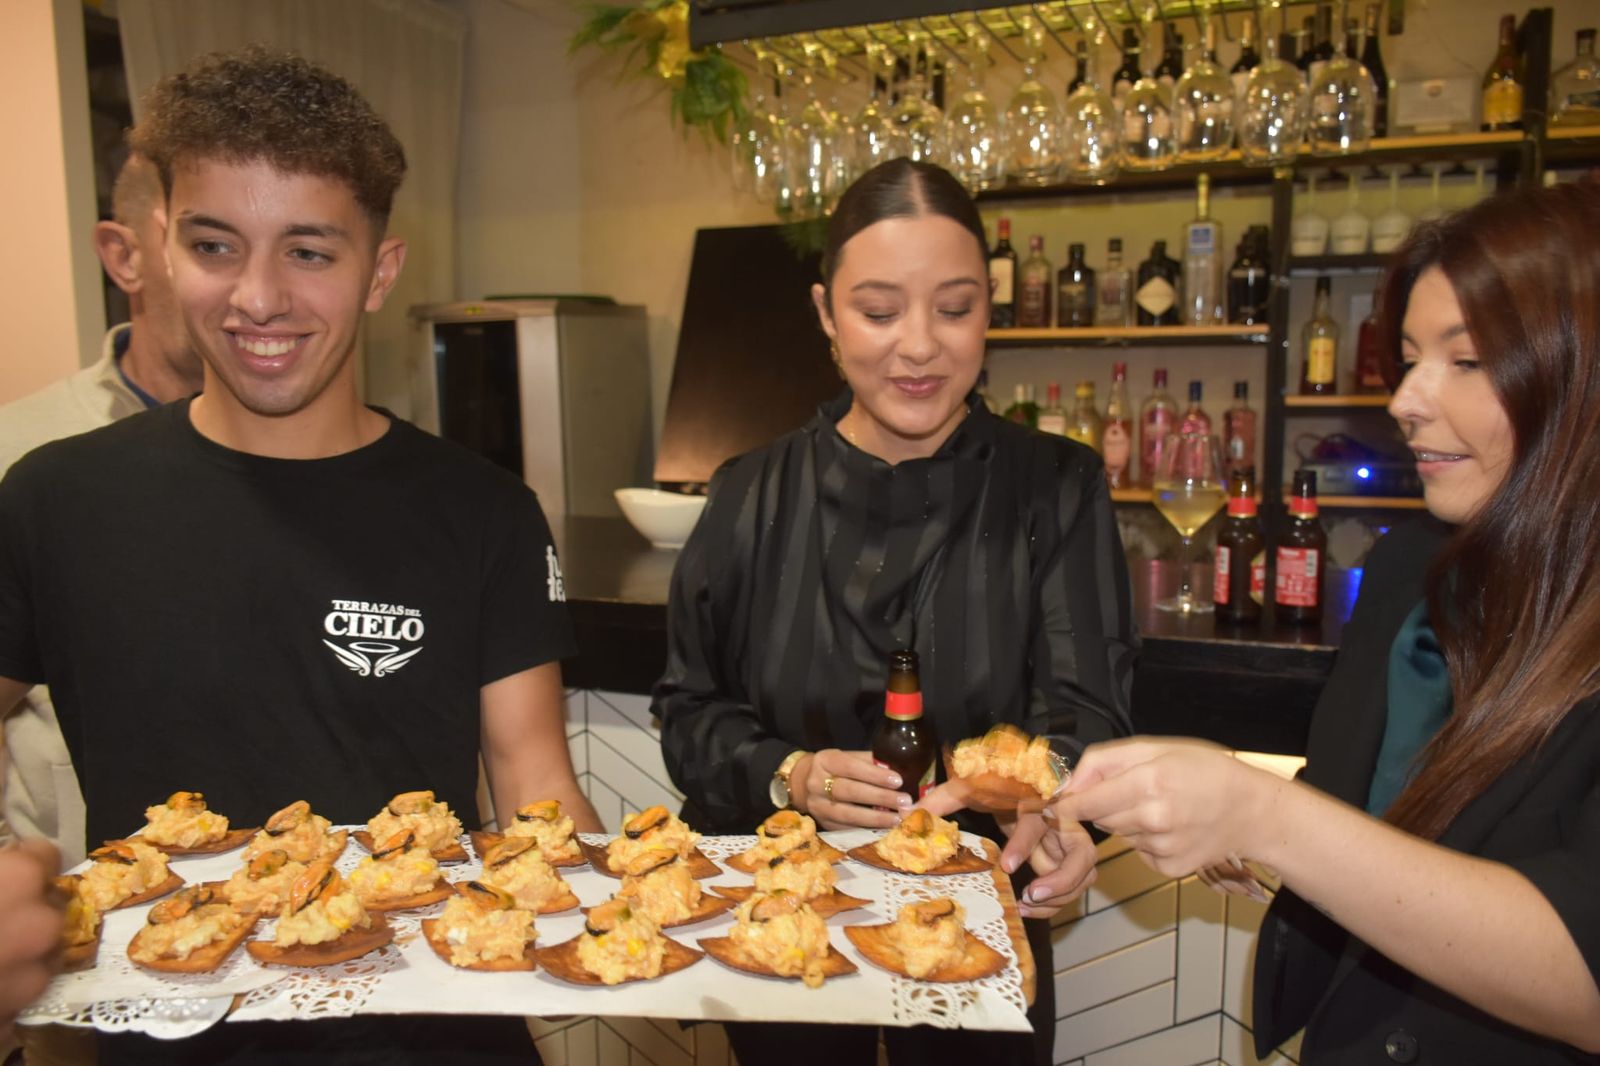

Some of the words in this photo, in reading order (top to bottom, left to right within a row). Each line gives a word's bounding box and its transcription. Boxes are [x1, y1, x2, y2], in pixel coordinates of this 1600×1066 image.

[331, 599, 404, 615] TERRAZAS
[405, 608, 422, 617] DEL
[324, 611, 425, 642] CIELO
